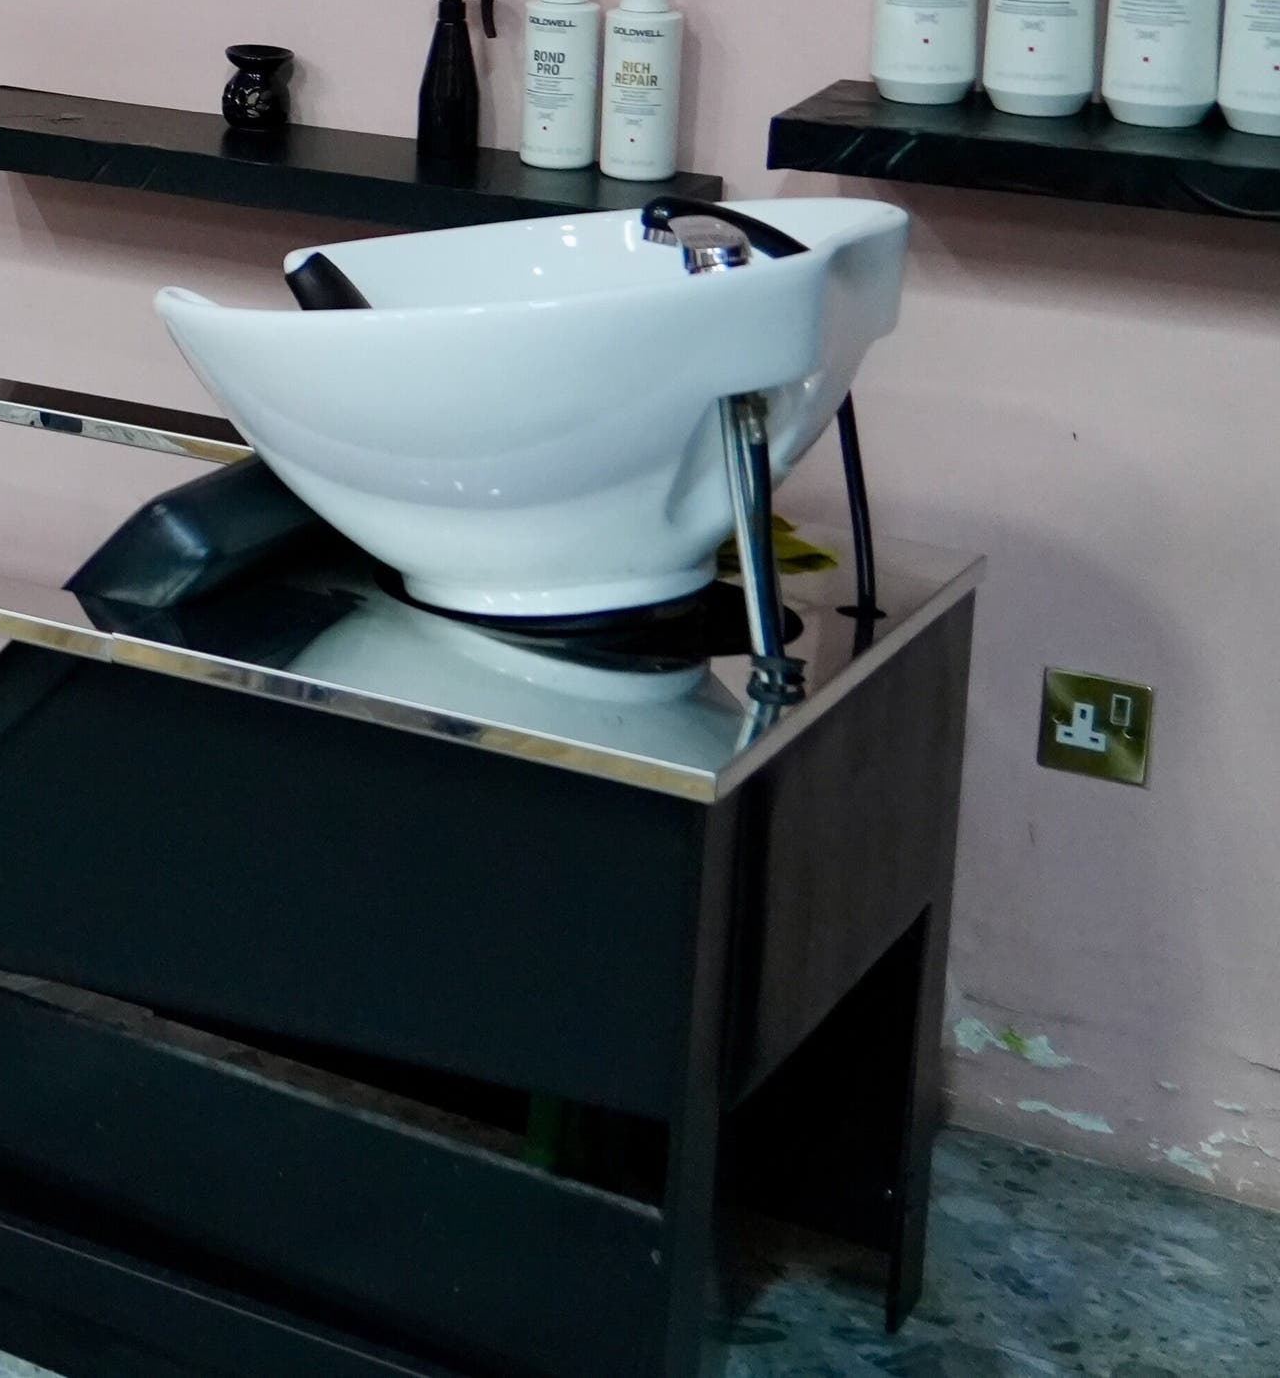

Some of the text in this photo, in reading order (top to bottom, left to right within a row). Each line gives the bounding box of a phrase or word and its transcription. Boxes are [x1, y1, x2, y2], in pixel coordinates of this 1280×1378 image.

[528, 15, 577, 28] GOLDWELL
[613, 26, 665, 38] GOLDWELL
[533, 49, 566, 64] BOND
[536, 63, 560, 76] PRO
[621, 61, 651, 74] RICH
[614, 72, 659, 87] REPAIR
